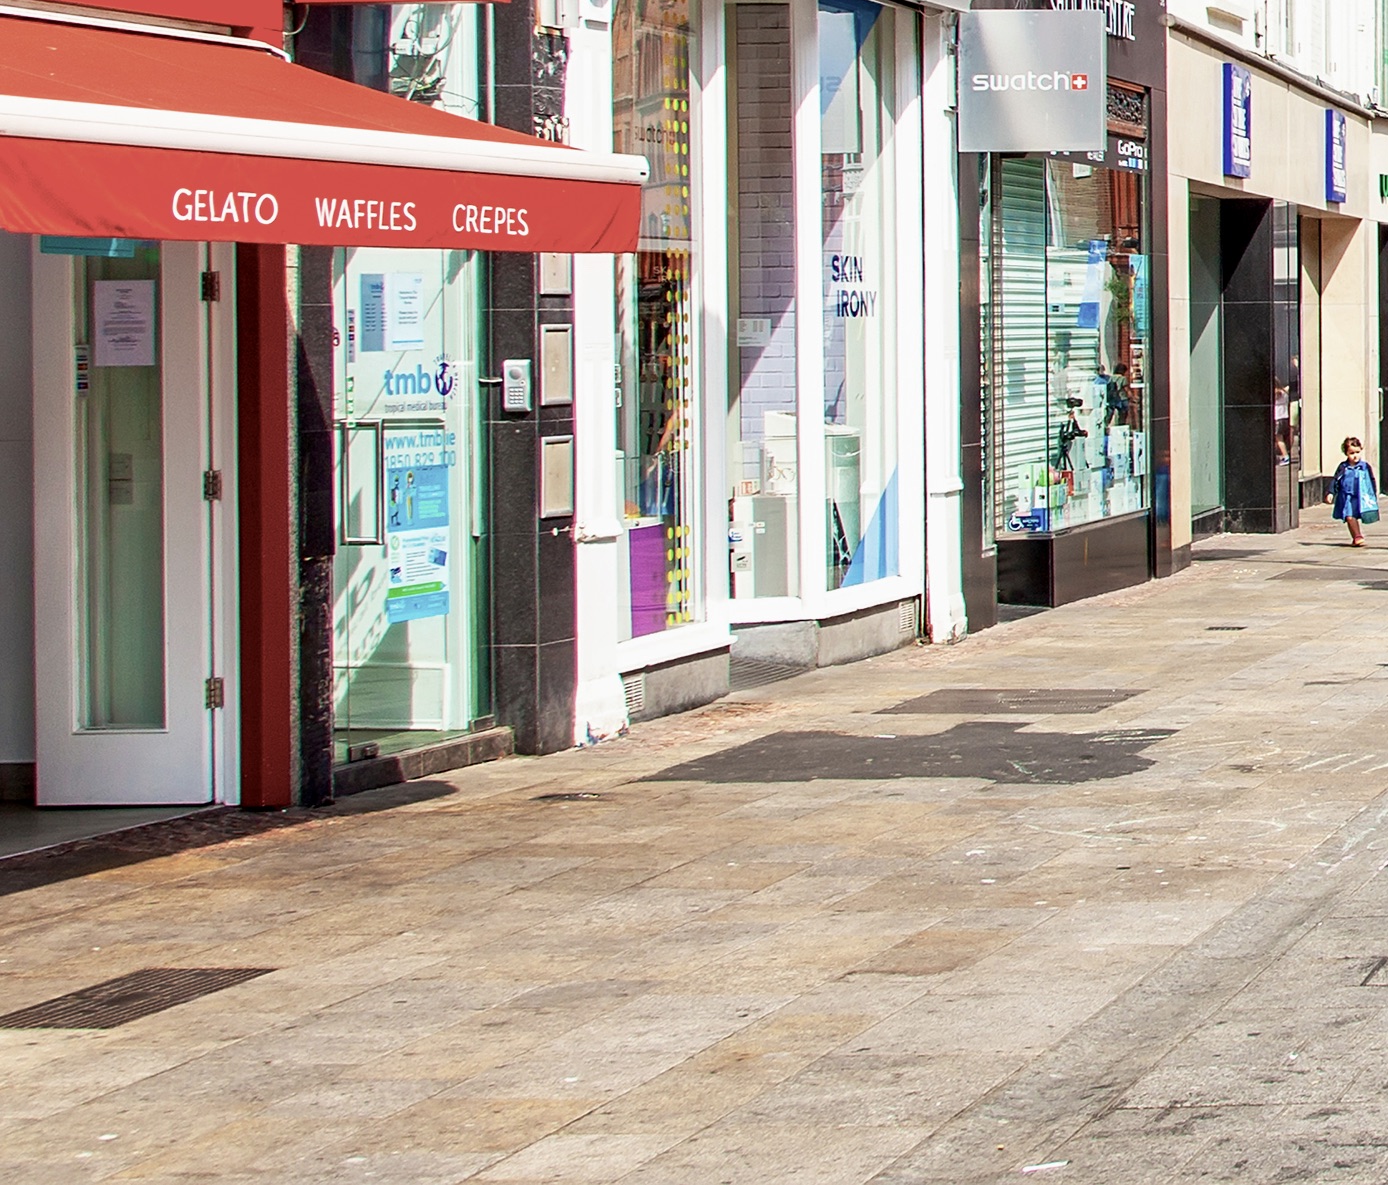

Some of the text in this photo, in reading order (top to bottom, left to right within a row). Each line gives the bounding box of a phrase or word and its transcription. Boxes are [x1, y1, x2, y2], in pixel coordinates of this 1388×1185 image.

[972, 71, 1070, 91] swatch
[1118, 139, 1144, 158] GoPro
[172, 188, 530, 236] GELATO WAFFLES CREPES
[831, 254, 863, 283] SKIN
[837, 290, 877, 317] IRONY
[384, 364, 431, 396] tmb
[384, 402, 405, 414] tropical
[406, 401, 428, 411] medical
